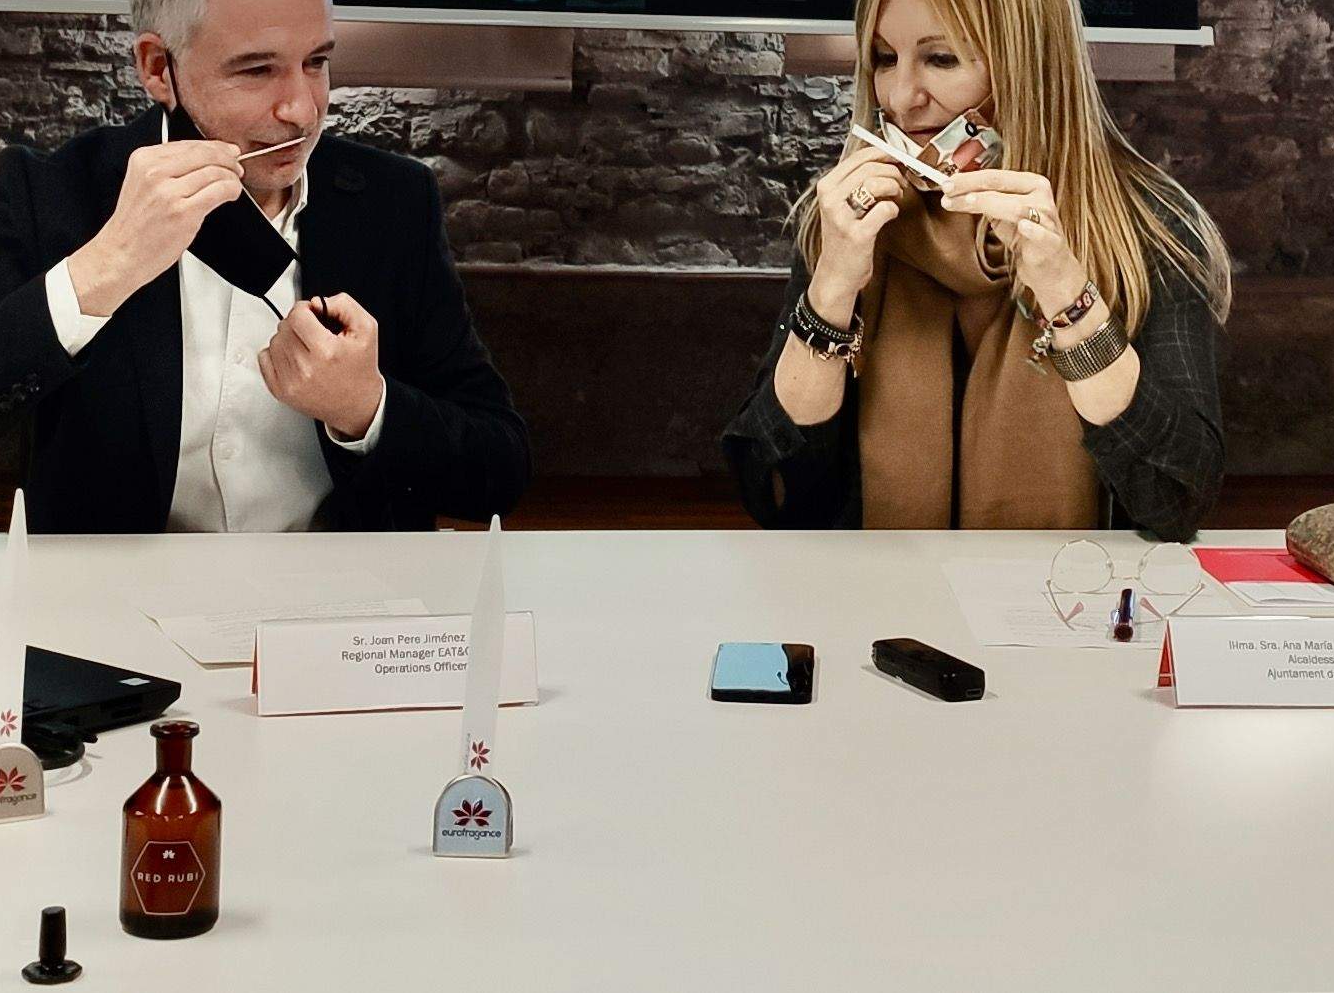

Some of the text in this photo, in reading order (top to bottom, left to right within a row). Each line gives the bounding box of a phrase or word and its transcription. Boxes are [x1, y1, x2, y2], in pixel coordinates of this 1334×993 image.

[352, 632, 466, 646] Sr. Joan Pere Jiménez
[1259, 640, 1281, 650] Sra.
[1283, 640, 1302, 650] Ana
[1304, 640, 1333, 650] María
[341, 650, 387, 663] Regional
[389, 648, 435, 660] Manager
[375, 661, 468, 675] Operations Officer
[1267, 668, 1325, 680] Ajuntament
[441, 828, 502, 840] eurofragance
[137, 871, 162, 883] RED
